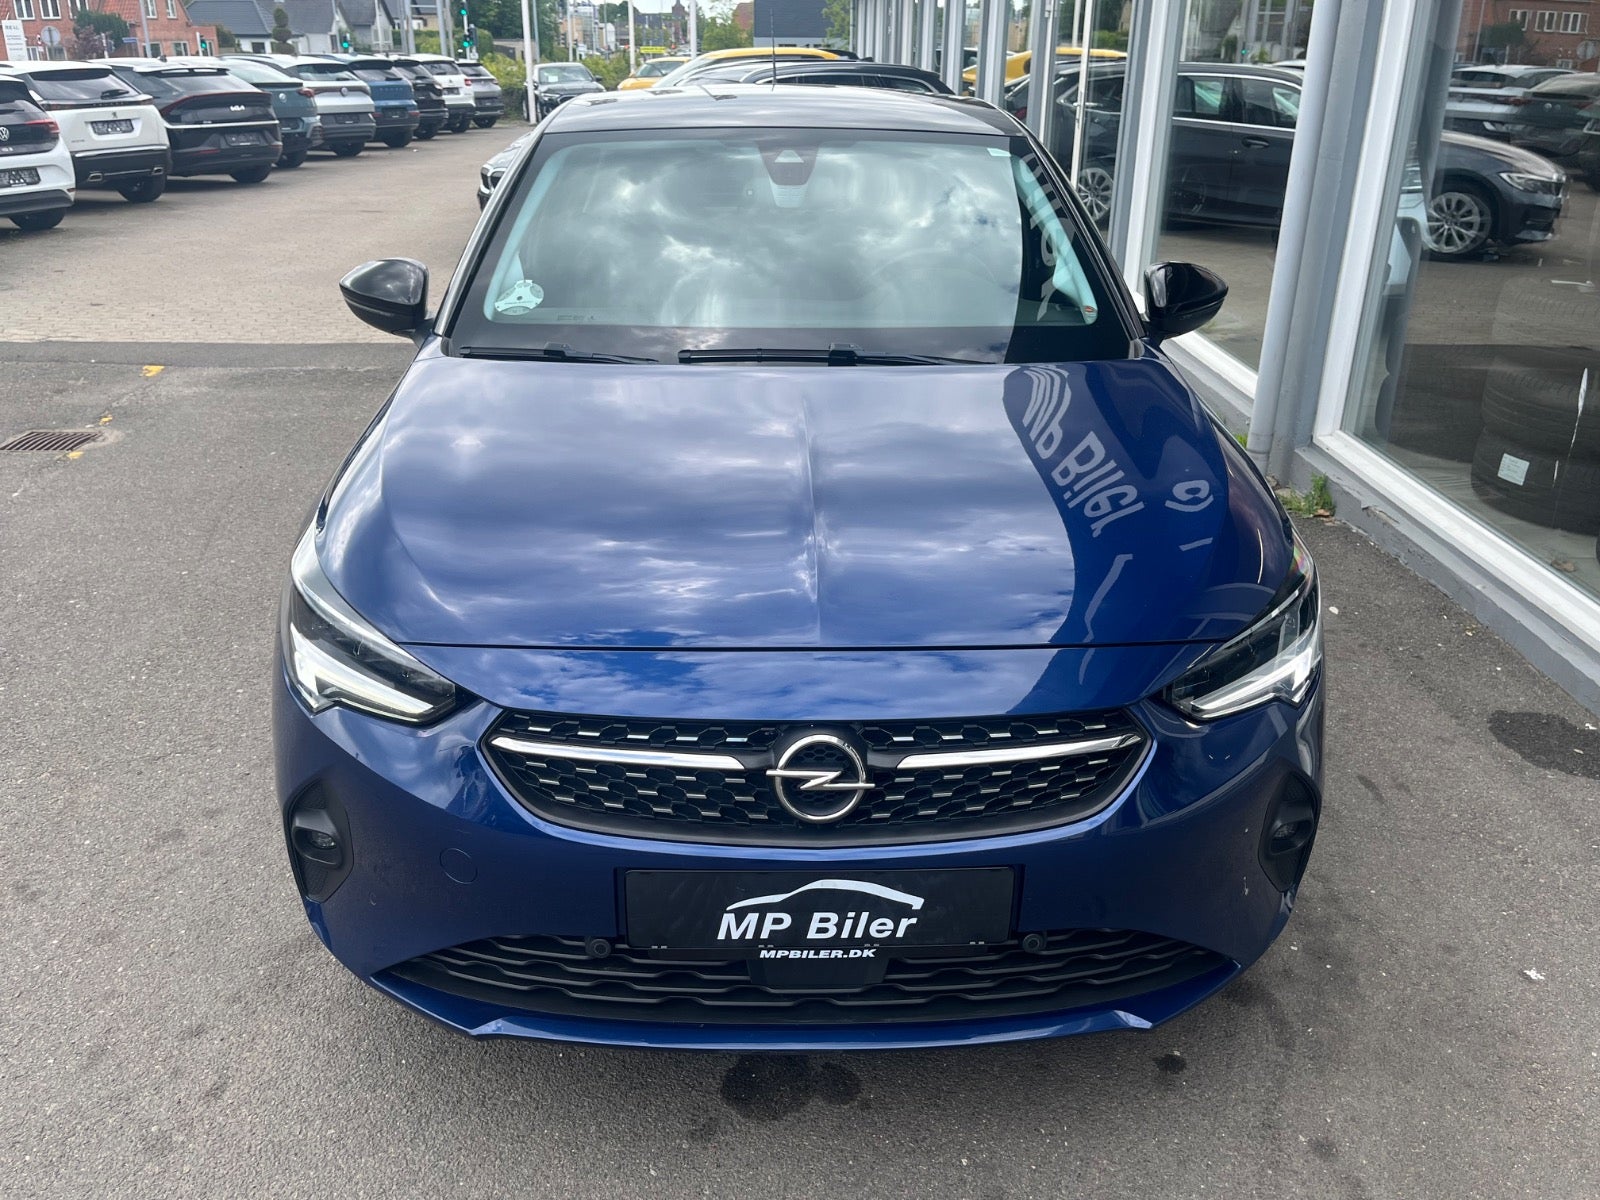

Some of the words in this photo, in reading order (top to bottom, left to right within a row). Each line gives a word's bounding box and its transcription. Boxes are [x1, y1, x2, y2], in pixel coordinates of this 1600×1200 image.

[717, 912, 791, 940] MP
[806, 911, 918, 939] Biler
[759, 948, 877, 959] MPBILER.DK
